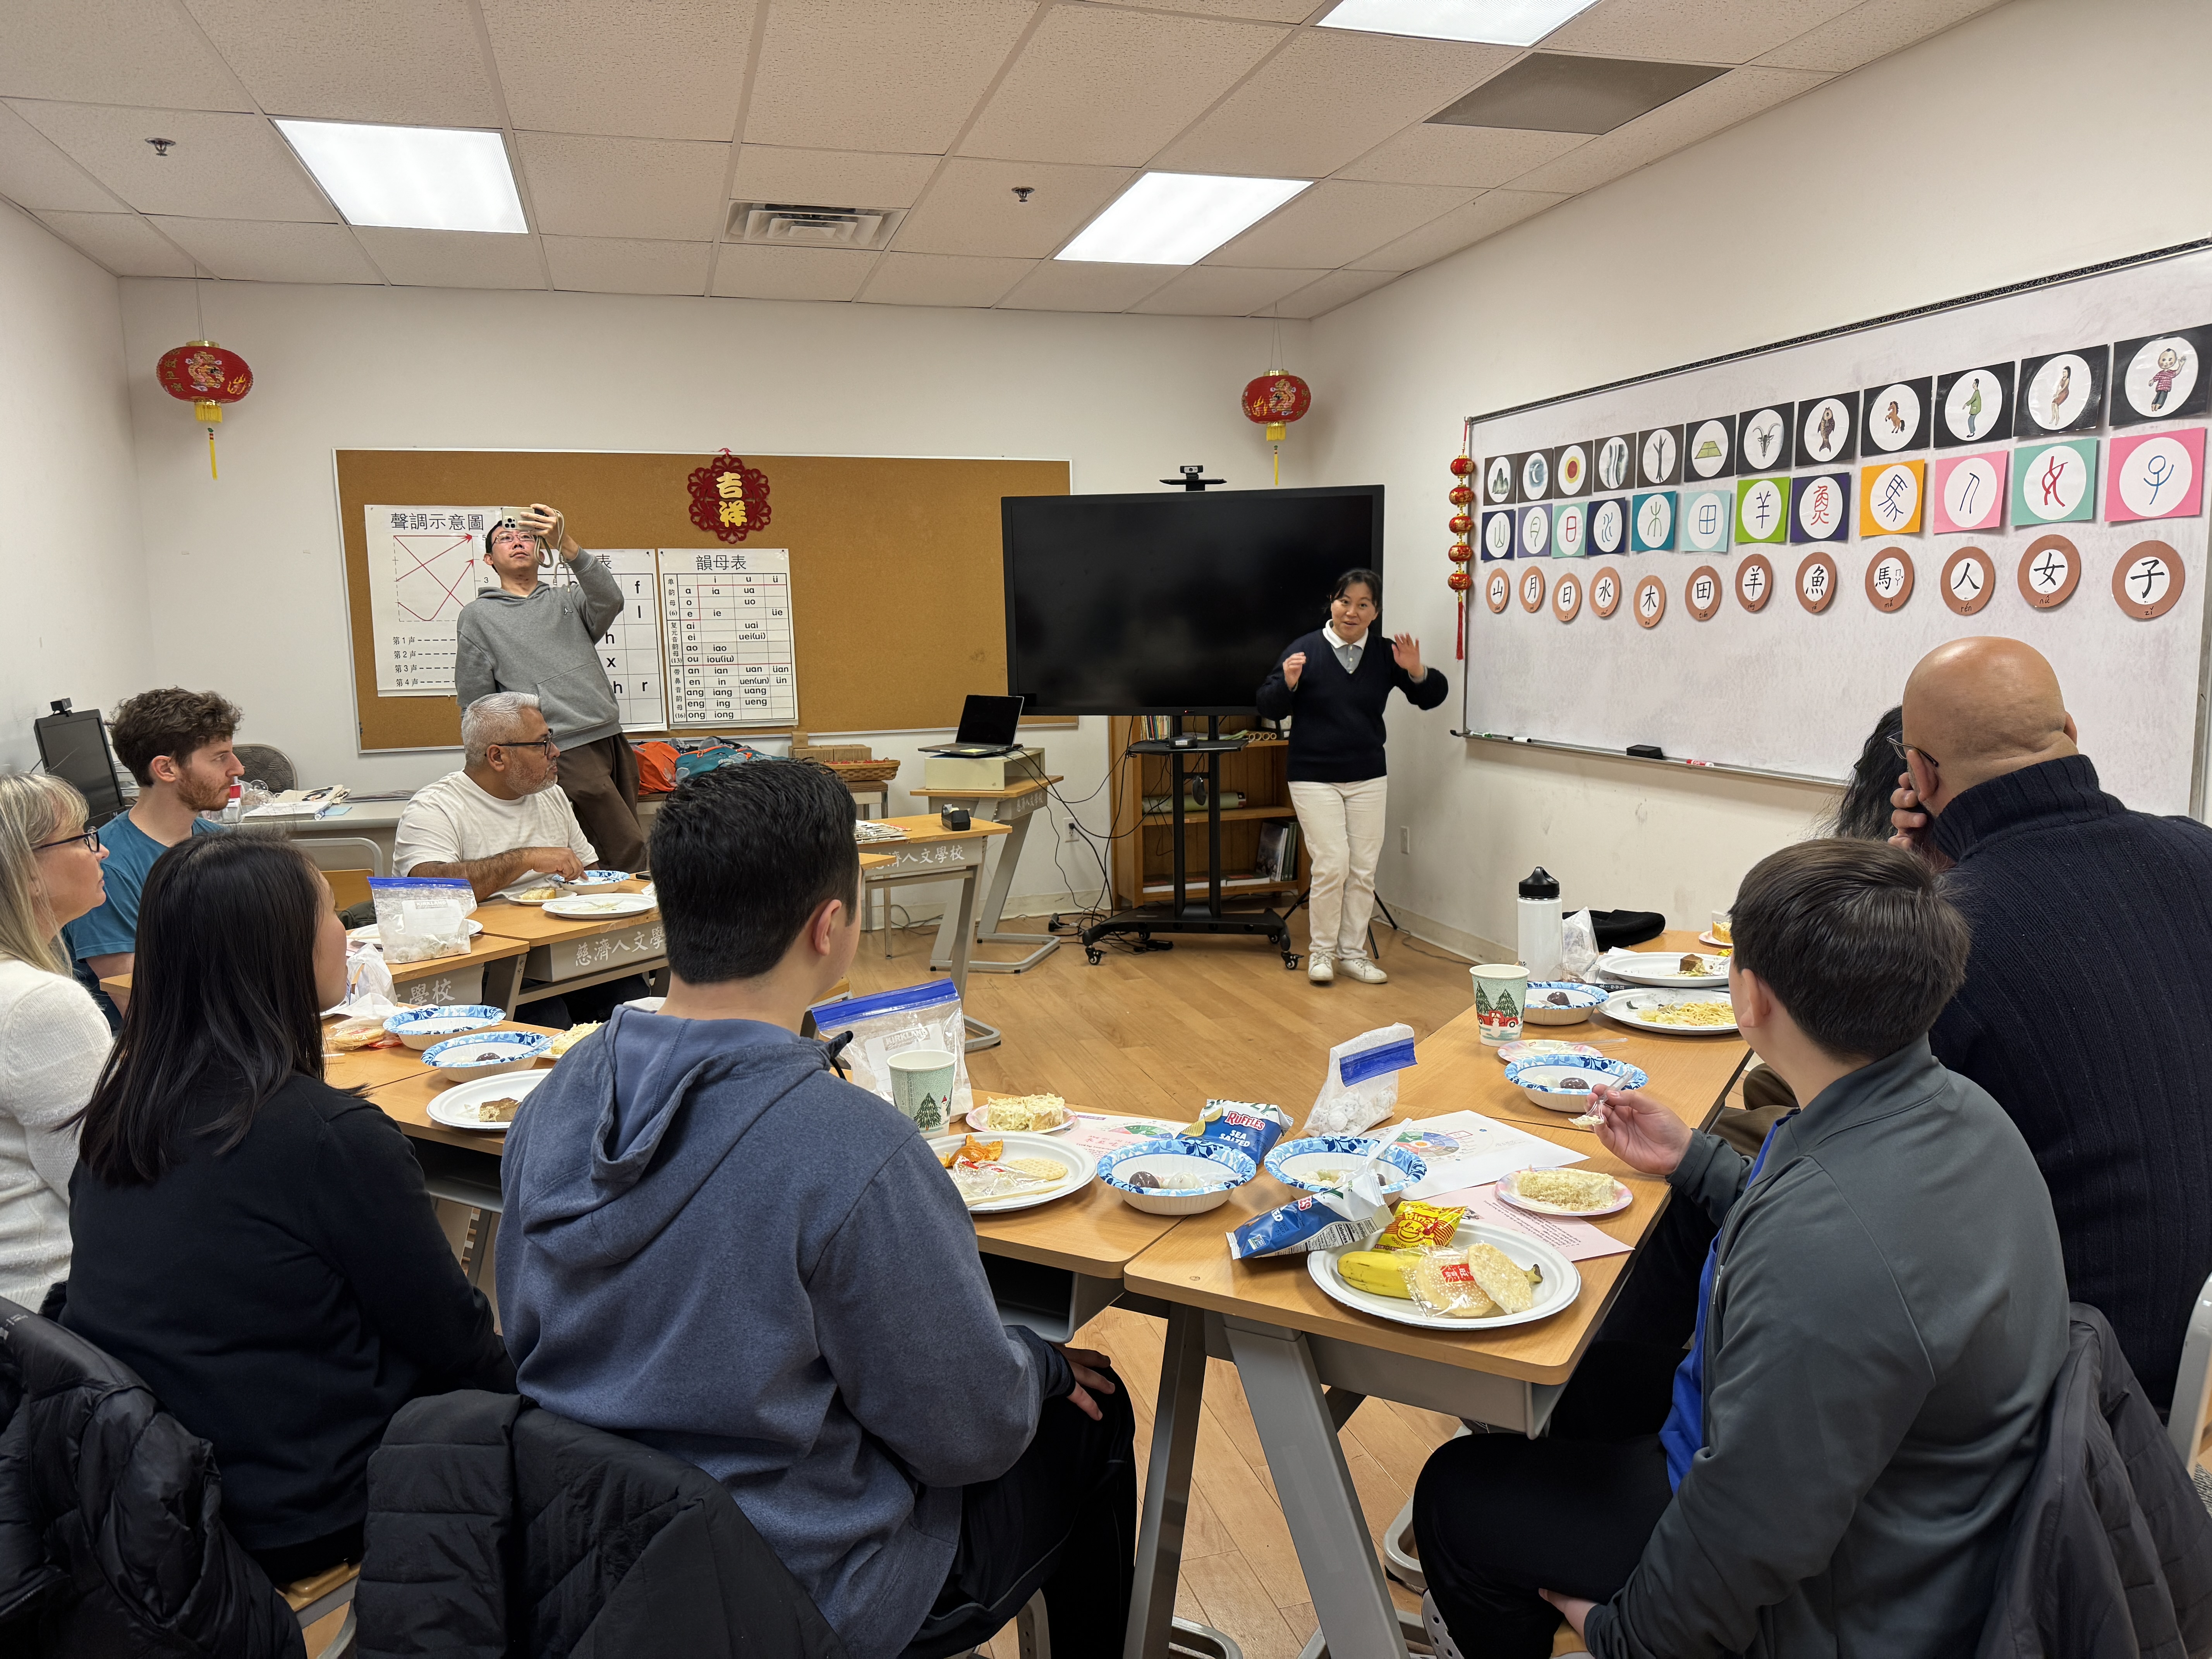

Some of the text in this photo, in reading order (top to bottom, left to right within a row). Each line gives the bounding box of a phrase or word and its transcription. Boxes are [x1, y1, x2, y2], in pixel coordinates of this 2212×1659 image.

[716, 472, 747, 527] 吉祥
[390, 512, 484, 531] 聲調示意圖
[696, 555, 746, 570] 韻母表
[2033, 552, 2065, 586] 女
[1744, 566, 1762, 597] 羊
[1805, 565, 1824, 596] 魚
[1875, 566, 1891, 590] 馬
[1952, 562, 1980, 590] 人
[2130, 559, 2165, 599] 子
[635, 581, 640, 594] f
[1492, 580, 1503, 598] 山
[1527, 576, 1537, 599] 月
[1563, 586, 1571, 604] 日
[1598, 579, 1611, 602] 水
[1696, 581, 1711, 600] 田
[1642, 585, 1657, 611] 木
[1961, 602, 1972, 612] rén
[605, 632, 615, 644] h
[606, 658, 616, 668] x
[707, 655, 734, 663] iou(iu)
[642, 681, 648, 692] r
[713, 689, 732, 697] iang
[744, 687, 766, 695] uang
[716, 700, 730, 708] ing
[872, 845, 965, 869] 濟人文學校
[1226, 1112, 1265, 1130] RUFFLES
[1218, 1133, 1251, 1147] SALTED
[1229, 1130, 1247, 1139] SEA
[1338, 1224, 1348, 1243] Calories
